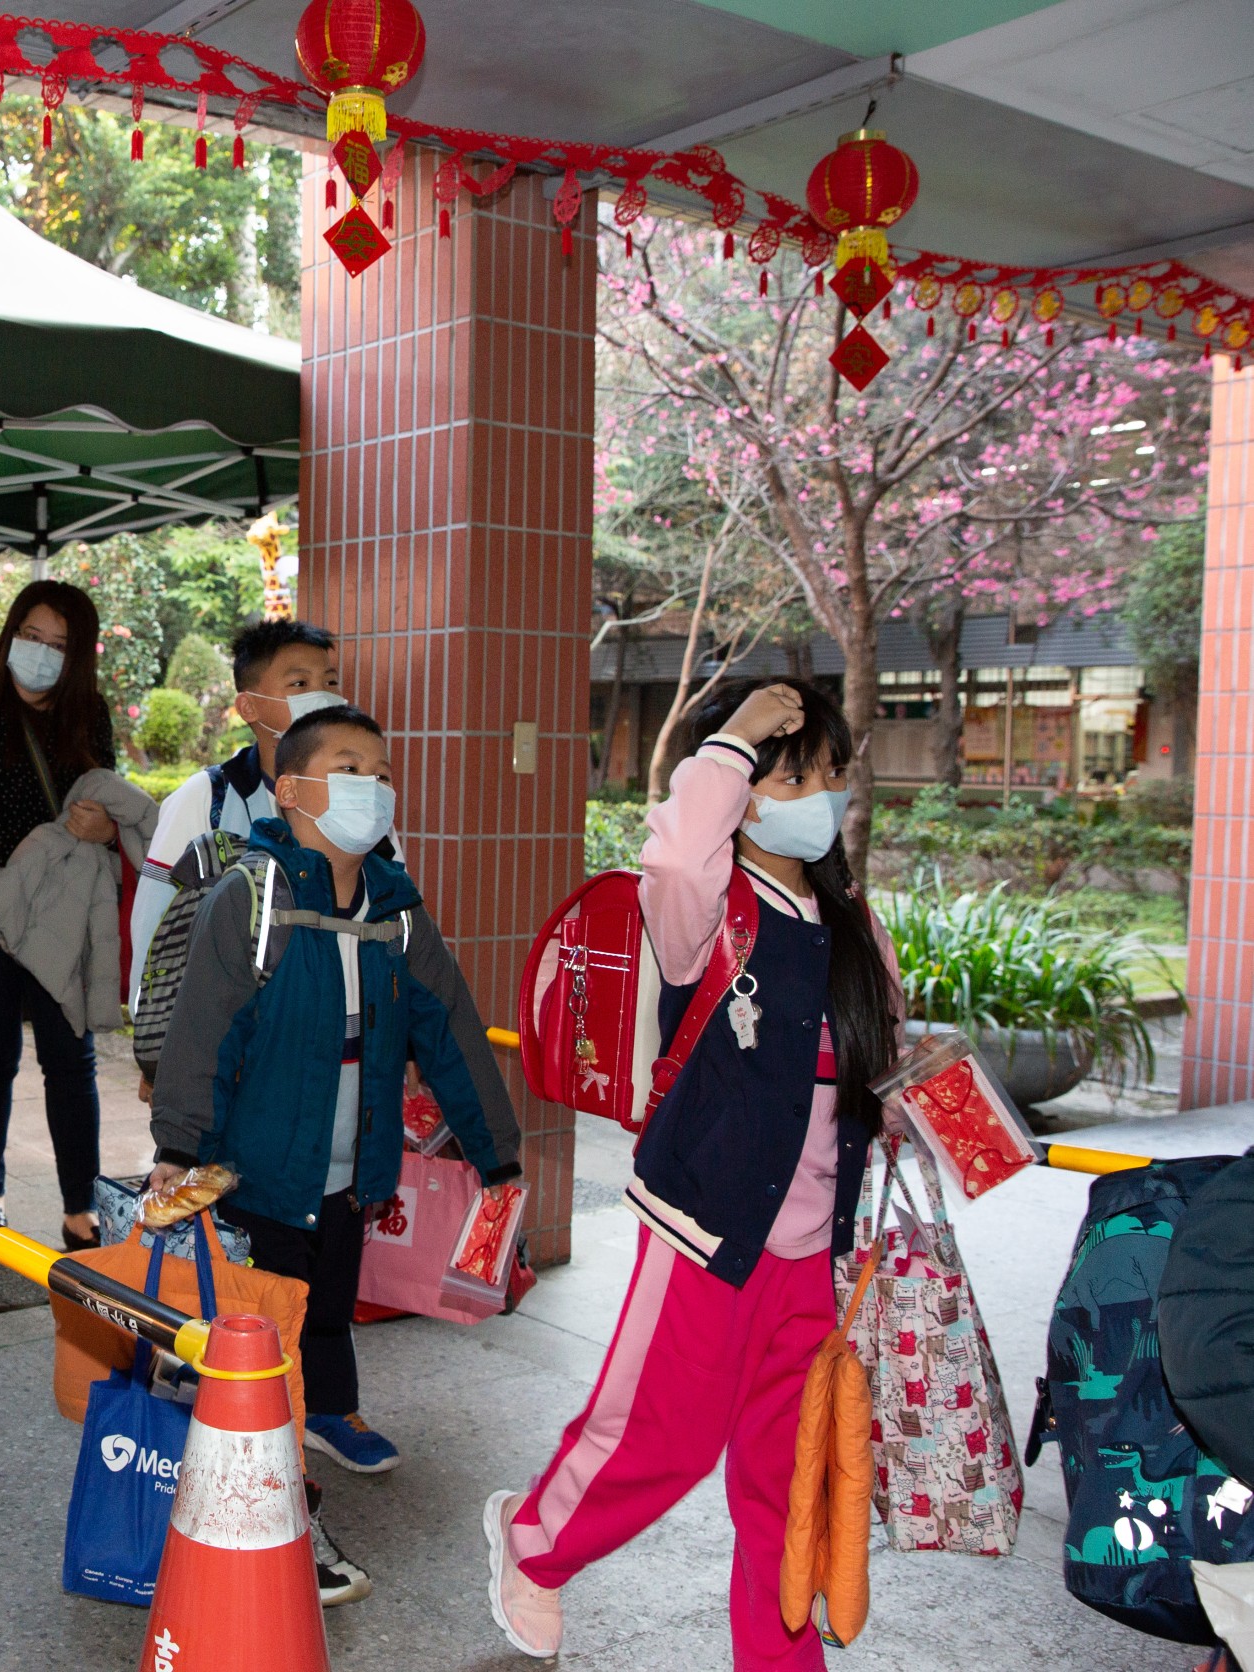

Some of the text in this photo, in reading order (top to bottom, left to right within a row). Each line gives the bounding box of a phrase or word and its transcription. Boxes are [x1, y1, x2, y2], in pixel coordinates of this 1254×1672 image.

[343, 138, 371, 185] 福
[334, 216, 378, 261] 安
[375, 1193, 408, 1237] 福
